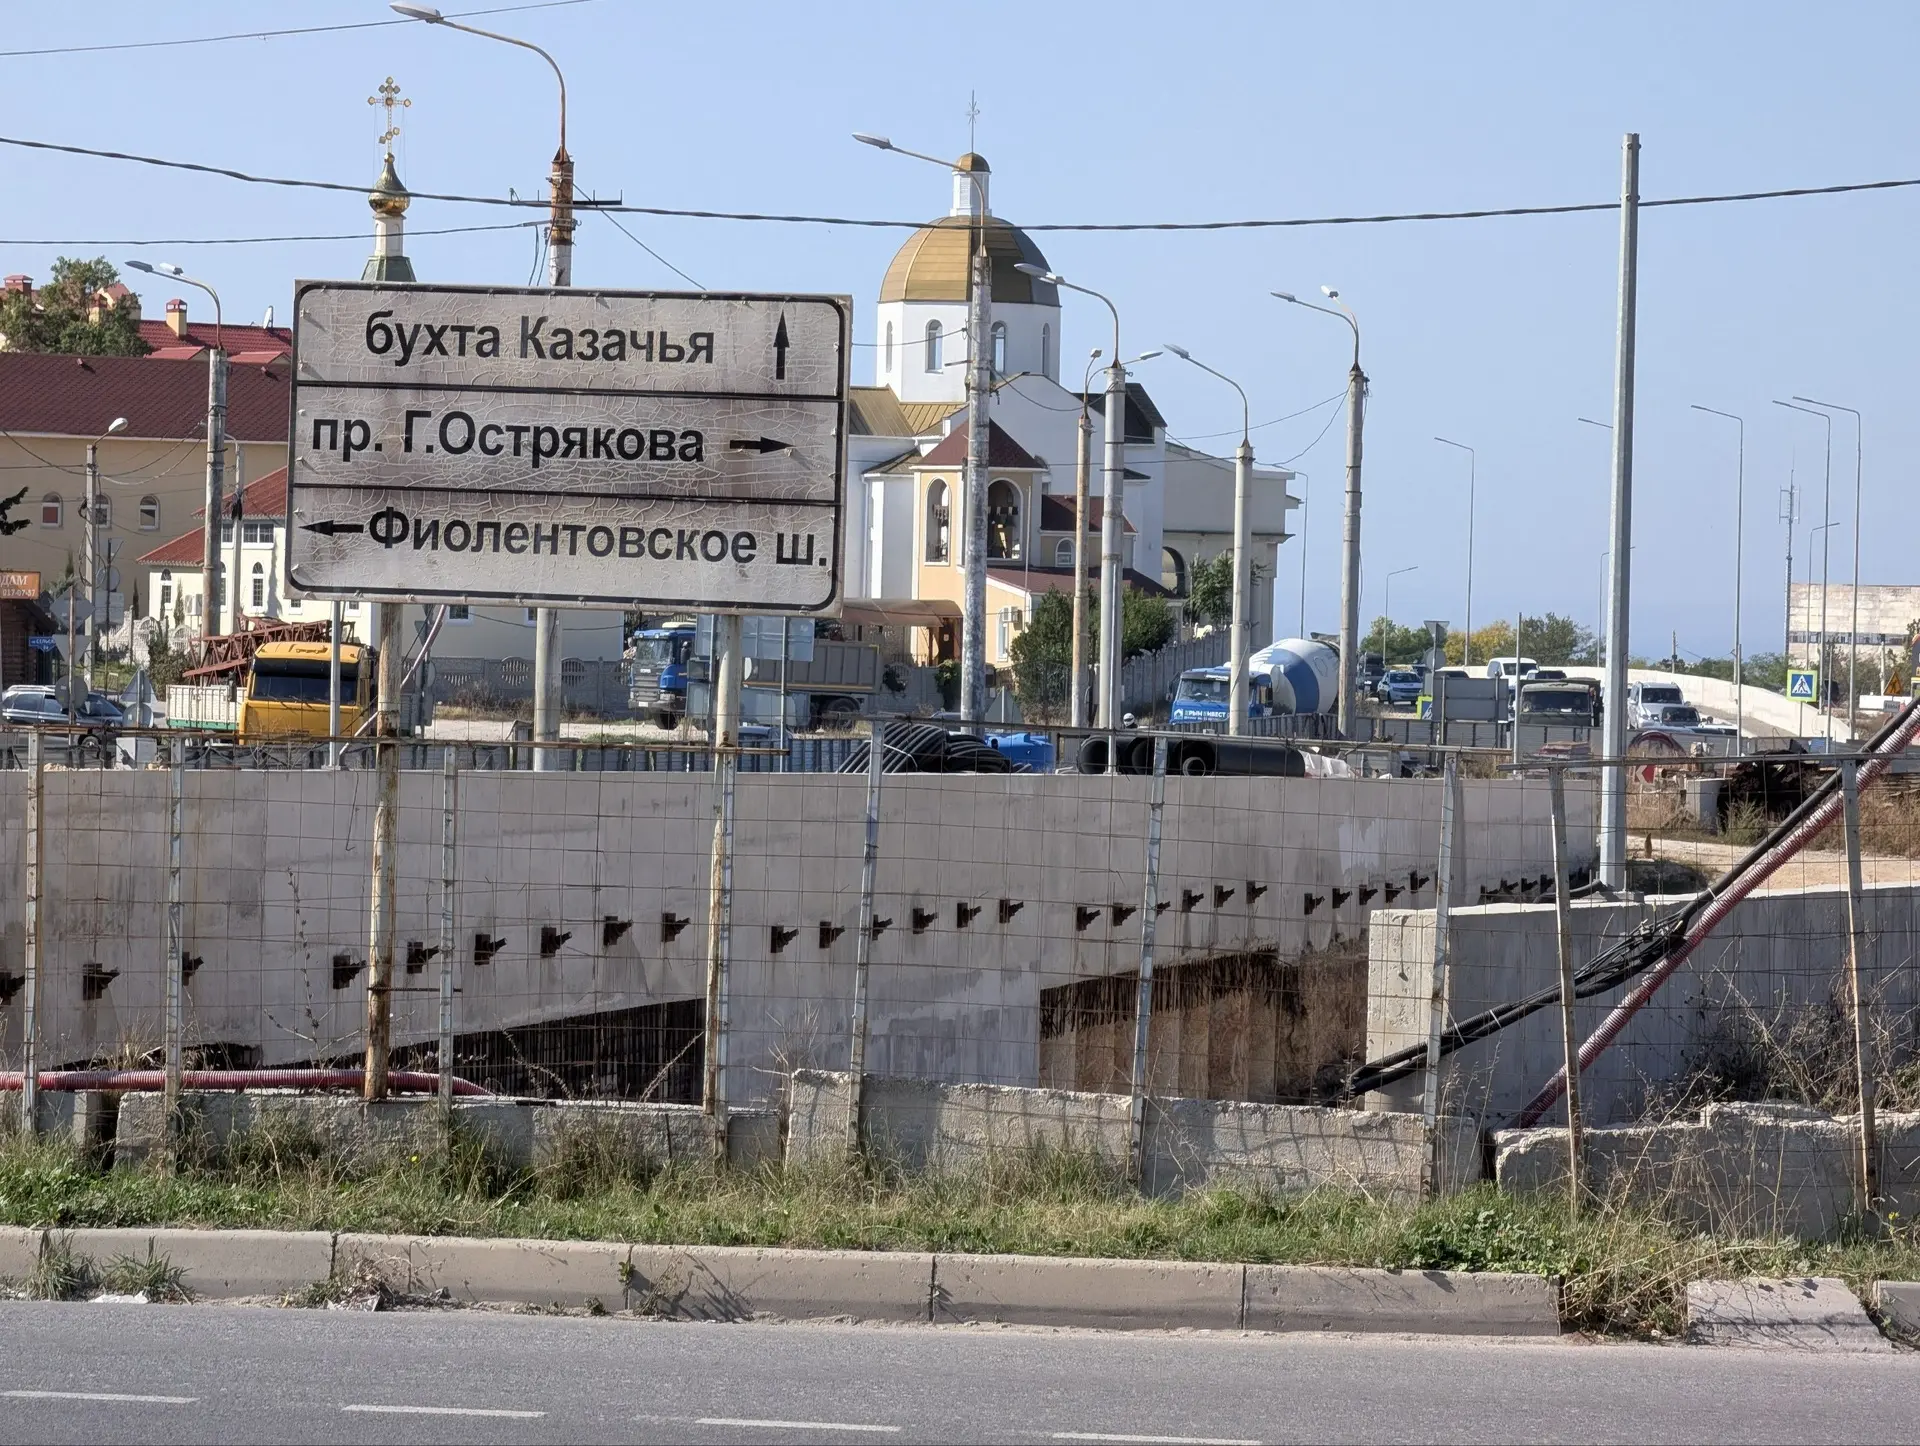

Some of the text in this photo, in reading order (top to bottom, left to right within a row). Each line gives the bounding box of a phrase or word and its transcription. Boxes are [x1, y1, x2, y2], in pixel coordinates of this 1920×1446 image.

[365, 310, 714, 367] бухта Казачья
[312, 409, 705, 469] пр. Г.Острякова
[368, 505, 828, 567] Фиолентовское ш.
[0, 574, 28, 587] ДАМ
